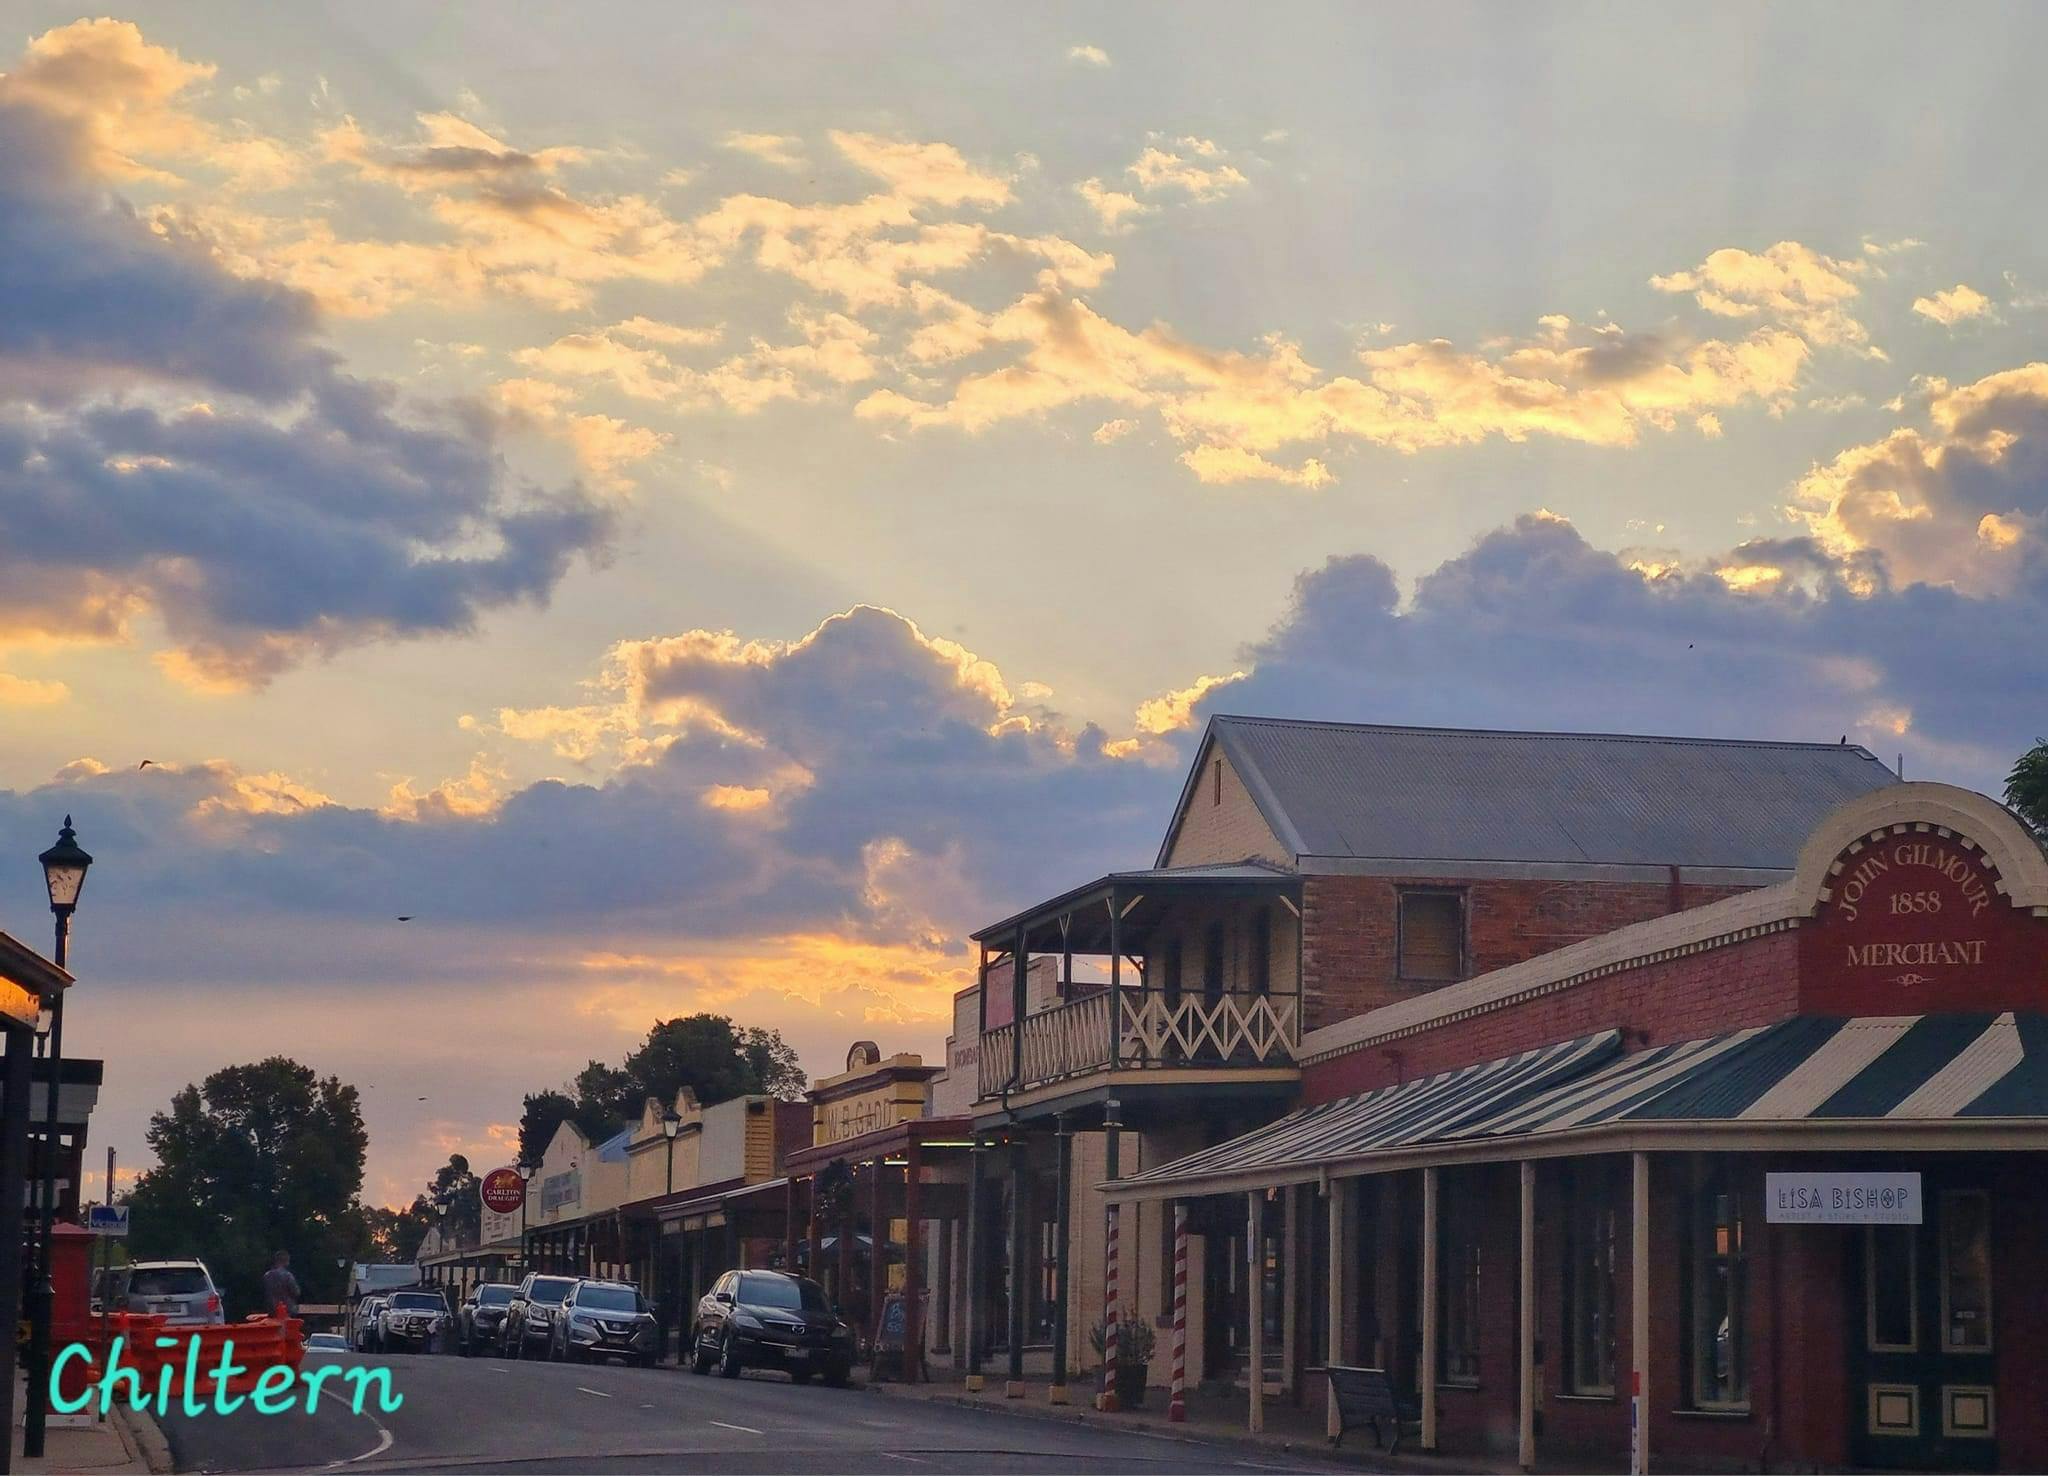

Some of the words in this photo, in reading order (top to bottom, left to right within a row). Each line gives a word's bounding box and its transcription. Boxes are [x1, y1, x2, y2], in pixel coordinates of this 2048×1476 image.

[1839, 851, 1889, 921] JOHN
[1894, 844, 1990, 920] GILMOUR
[1890, 891, 1942, 914] 1858
[1848, 940, 1986, 966] MERCHANT
